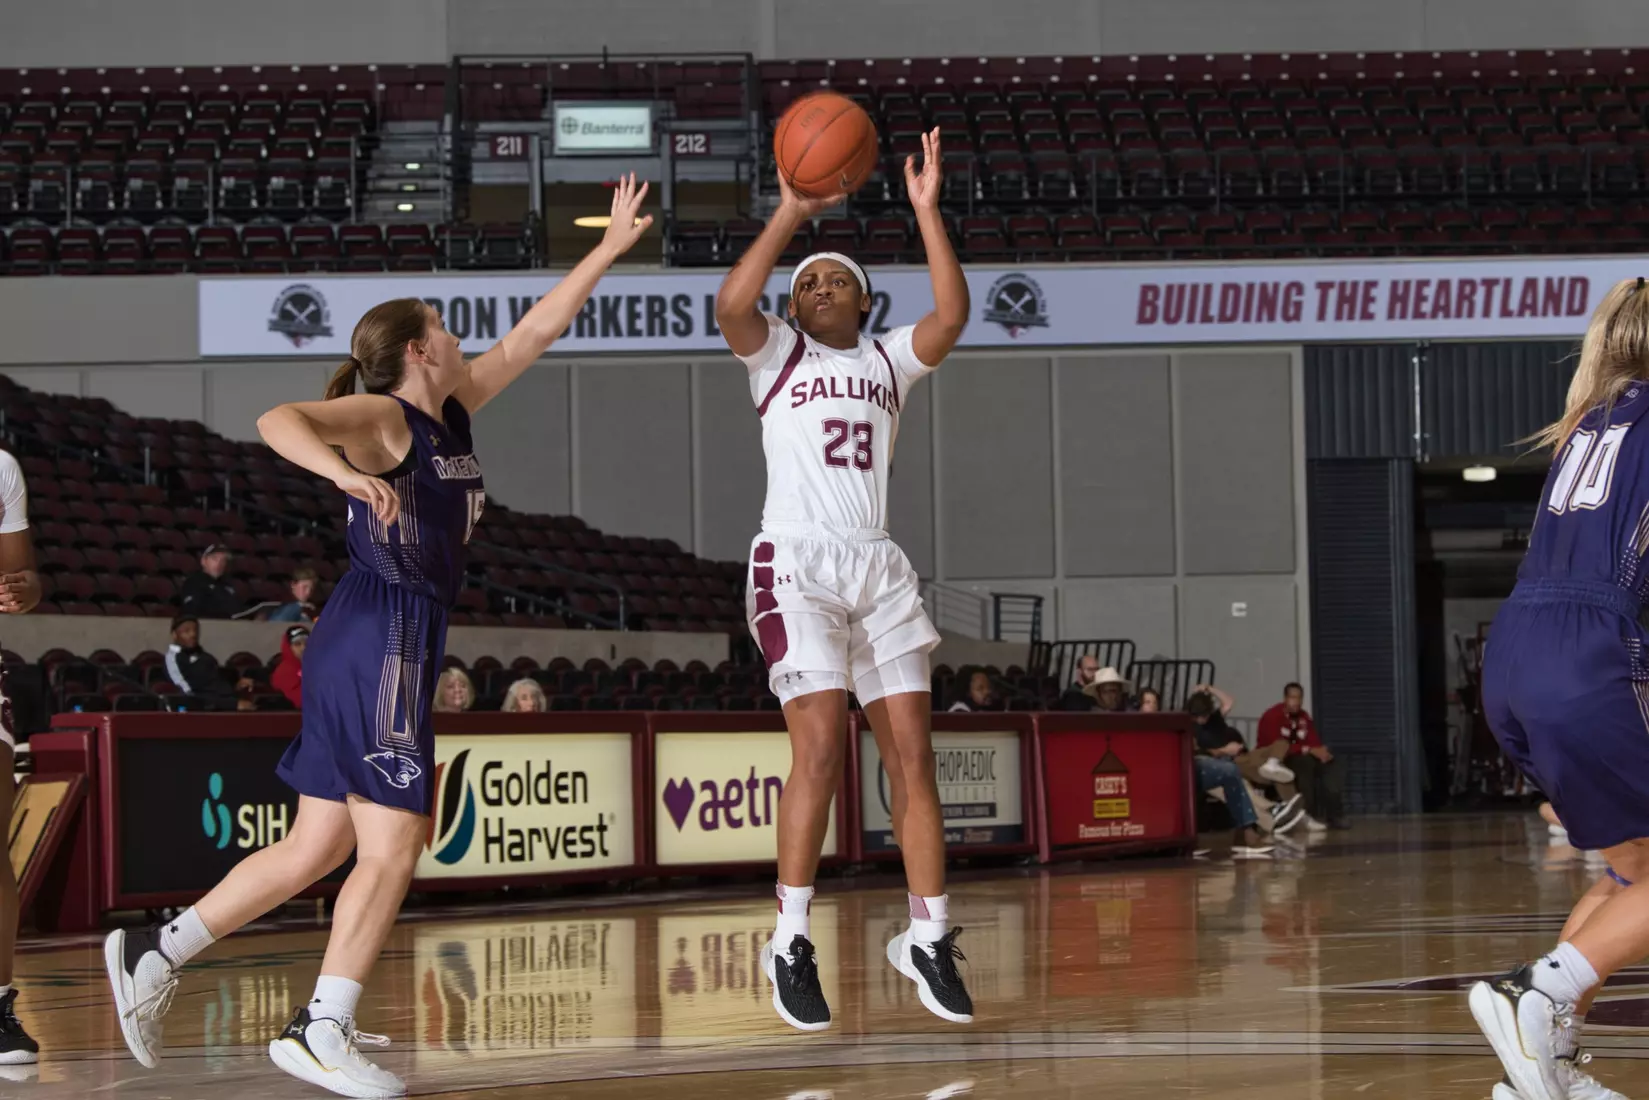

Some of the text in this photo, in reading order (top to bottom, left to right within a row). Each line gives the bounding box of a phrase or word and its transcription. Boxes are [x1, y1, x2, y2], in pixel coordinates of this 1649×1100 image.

[496, 136, 523, 156] 211
[581, 121, 646, 136] Banterra
[674, 134, 706, 154] 212
[508, 292, 694, 338] RKERS
[1136, 275, 1591, 325] BUILDING THE HEARTLAND
[791, 376, 894, 417] SALUKIS
[821, 417, 875, 472] 23
[1547, 422, 1633, 516] 10
[481, 760, 589, 807] Golden
[237, 803, 288, 849] SIH
[484, 813, 609, 864] Harvest
